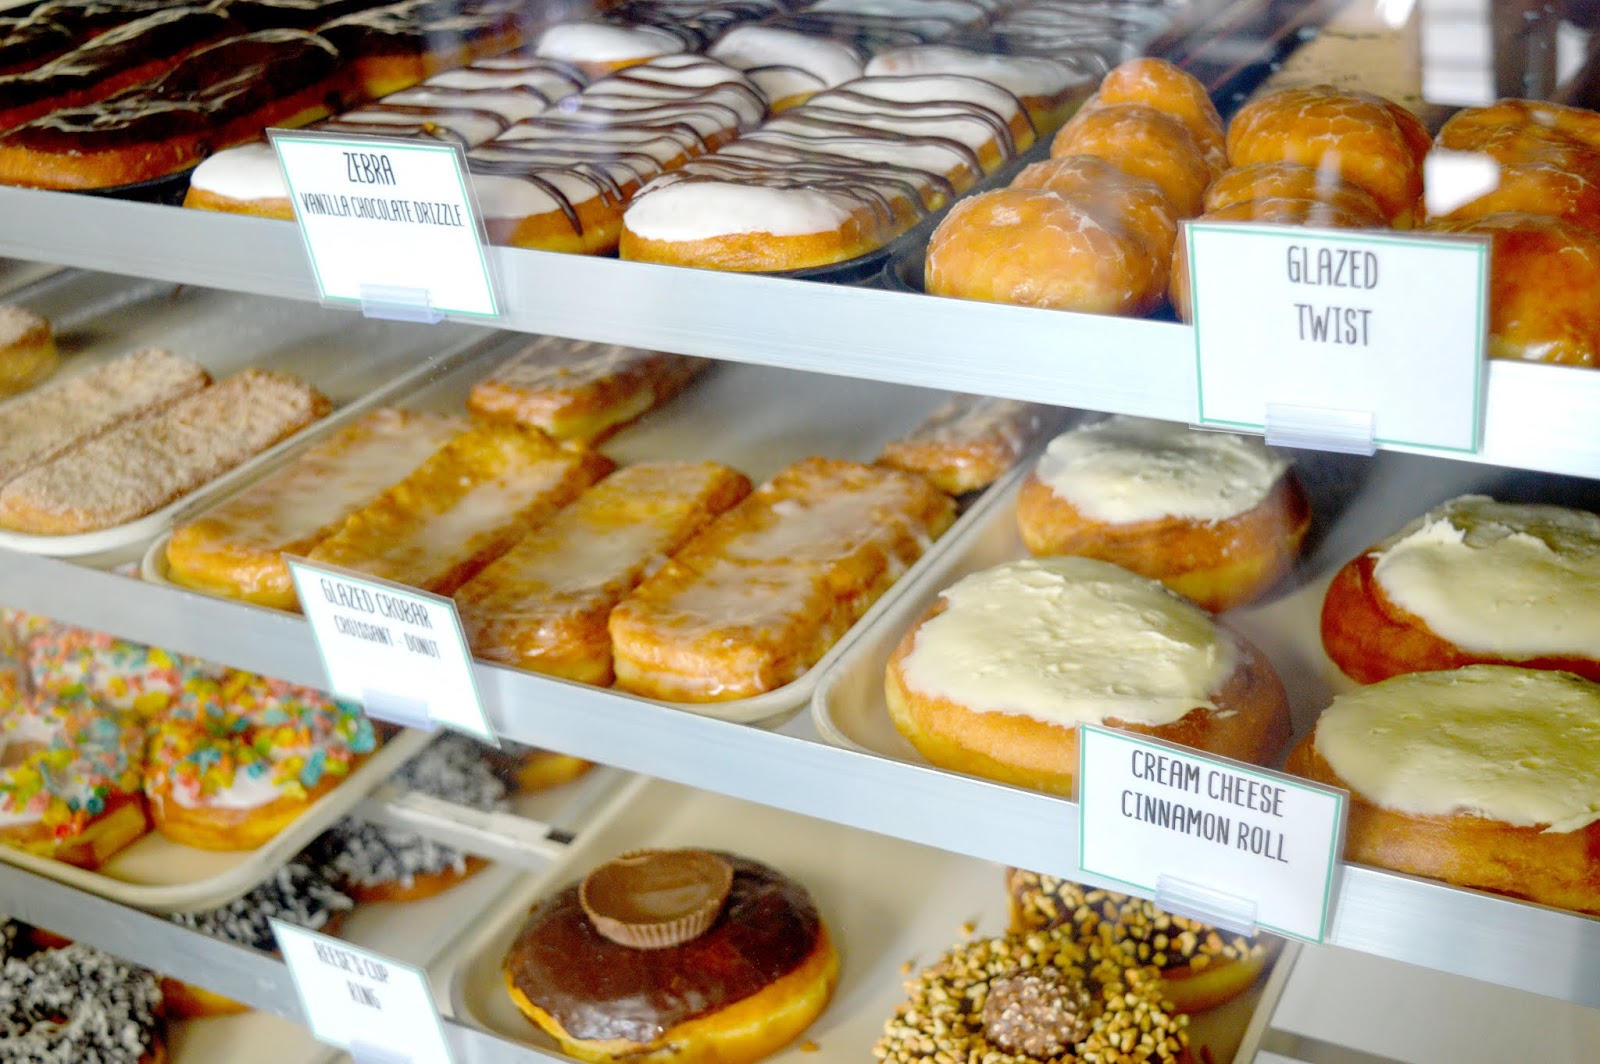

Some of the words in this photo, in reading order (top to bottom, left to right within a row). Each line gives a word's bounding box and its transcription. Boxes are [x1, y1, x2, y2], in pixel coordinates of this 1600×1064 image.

[343, 152, 396, 186] ZEBRA
[300, 192, 351, 217] VANILLA
[350, 196, 414, 223] CHOCOLATE
[413, 201, 464, 227] DRIZZLE
[1287, 245, 1378, 290] GLAZED
[1294, 304, 1372, 346] TWIST
[320, 578, 375, 614] GLAZED
[375, 593, 433, 629] CROBAR
[334, 615, 394, 647] CROISSANT
[404, 633, 440, 659] DONUT
[1131, 750, 1200, 794] CREAM
[1207, 771, 1286, 817] CHEESE
[1121, 790, 1230, 845] CINNAMON
[1237, 821, 1288, 863] ROLL
